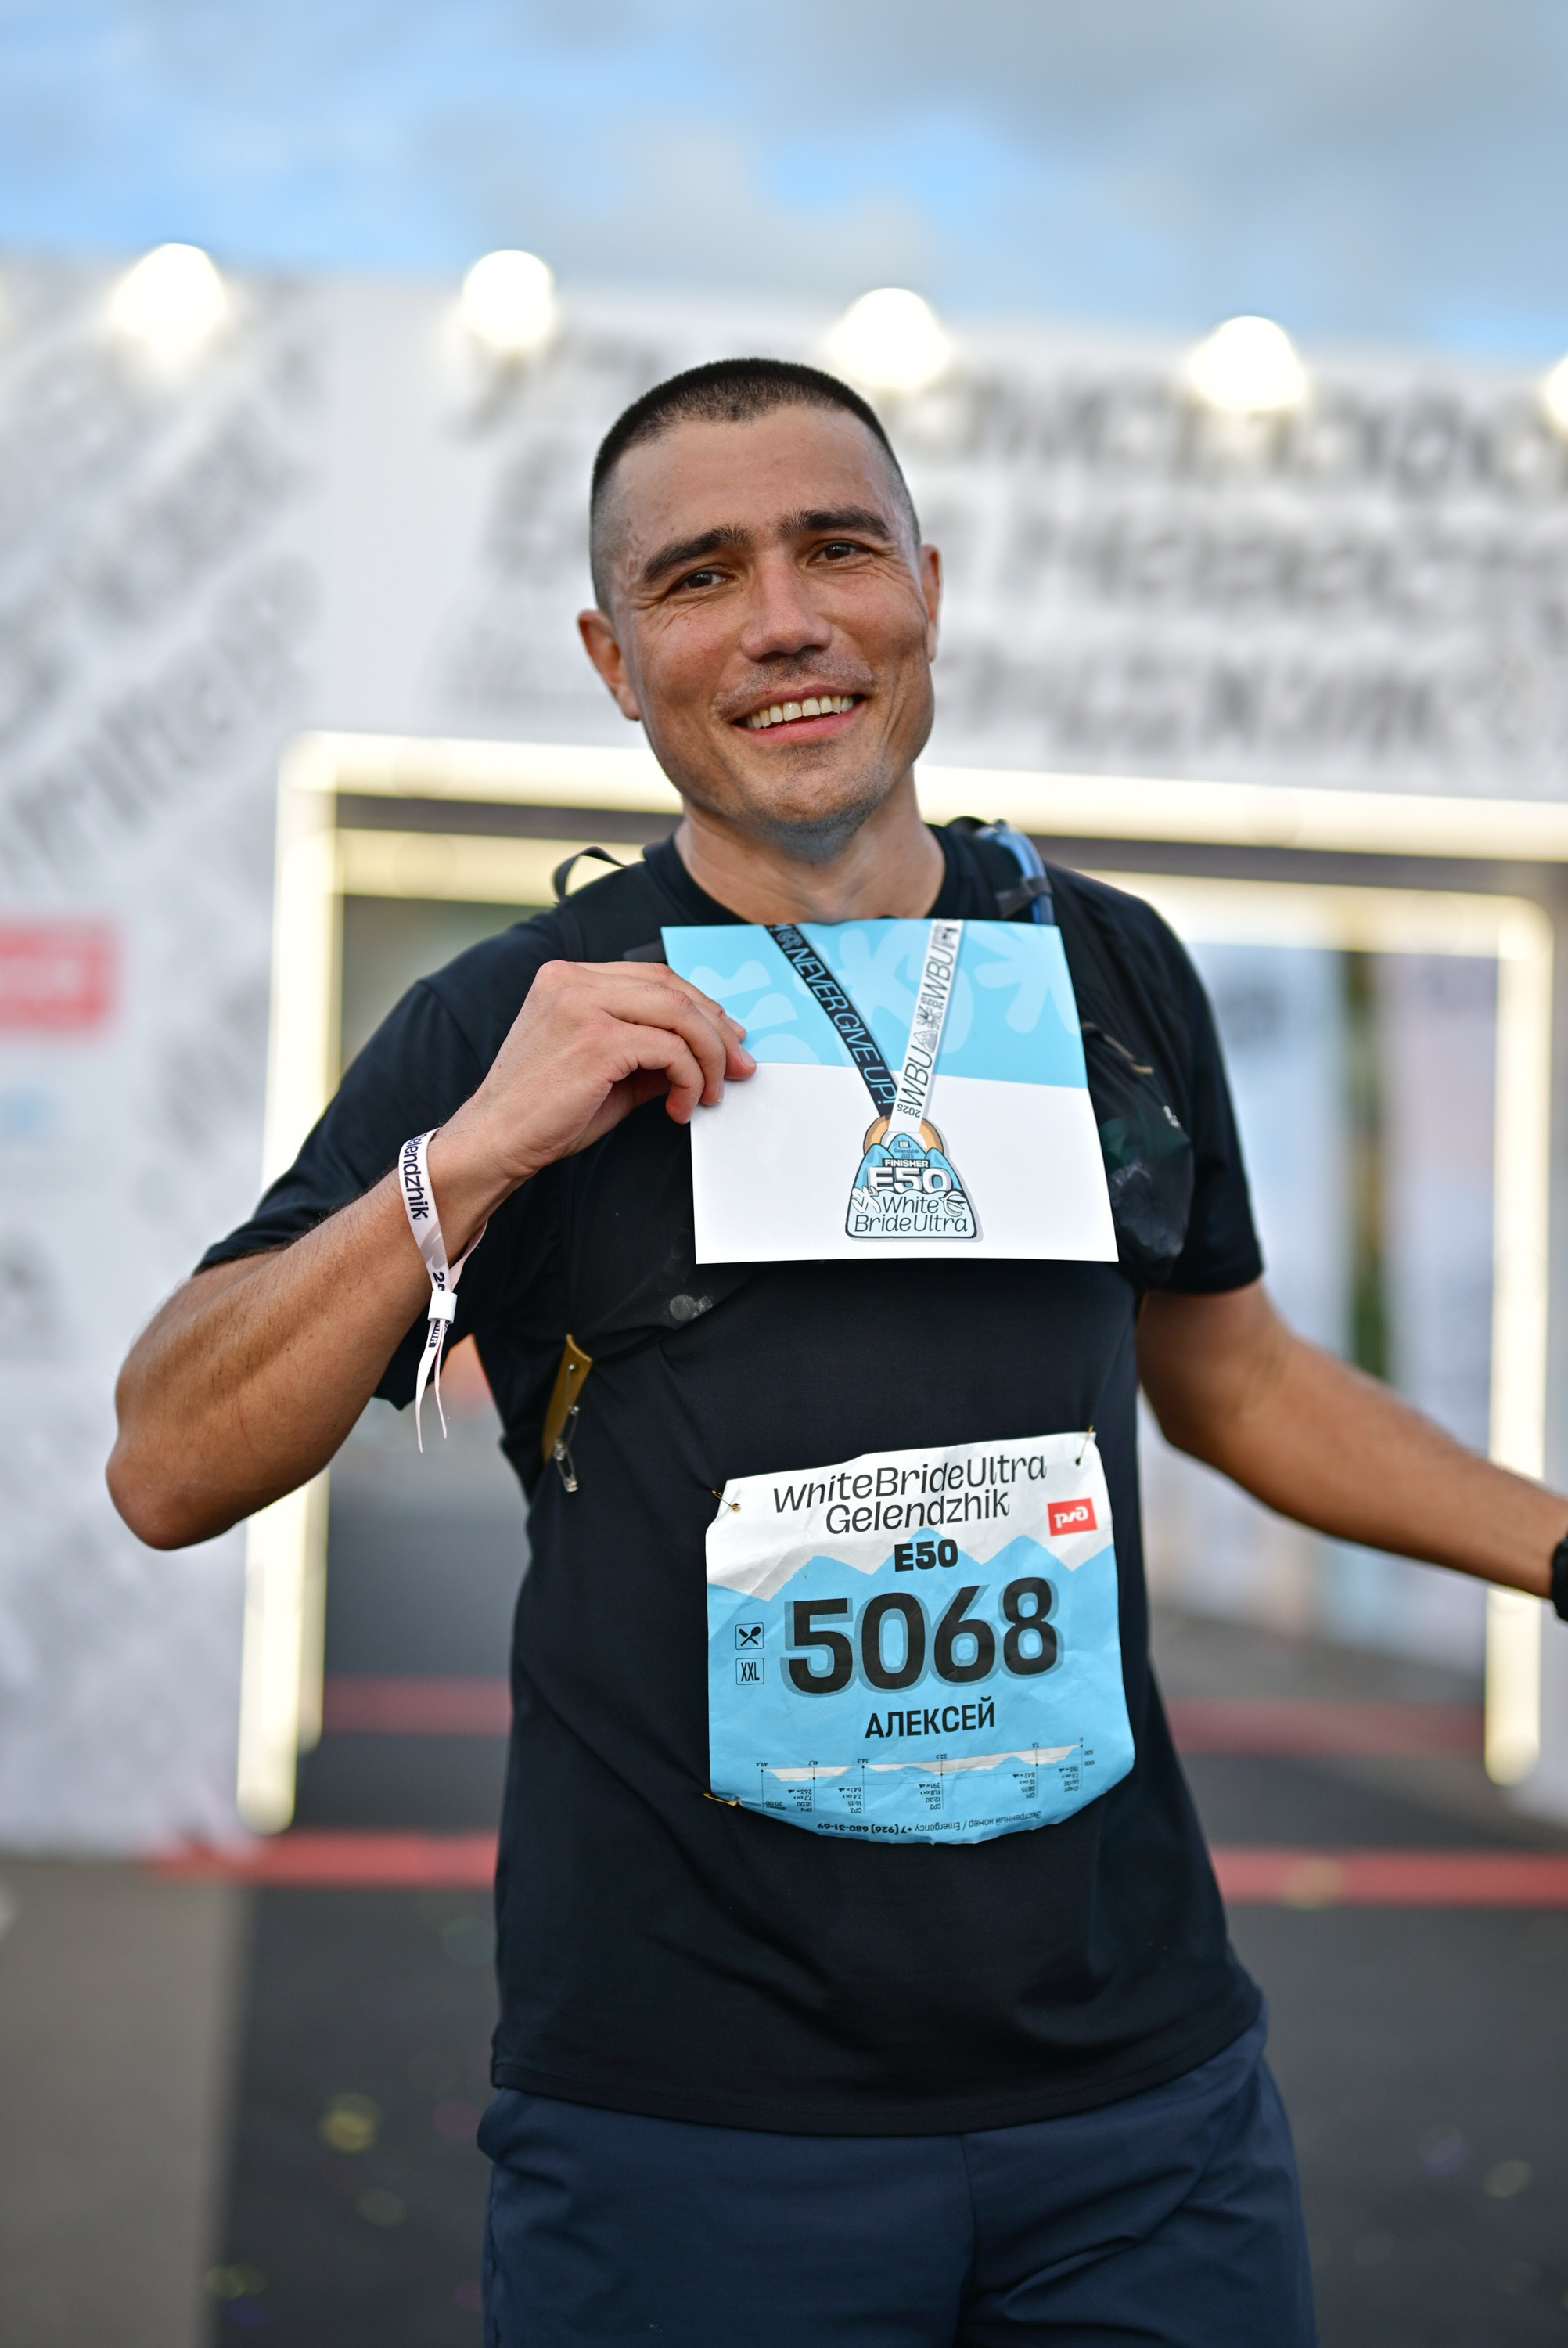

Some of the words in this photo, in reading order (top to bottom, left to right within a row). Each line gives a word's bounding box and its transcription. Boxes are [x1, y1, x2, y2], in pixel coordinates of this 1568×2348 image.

[921, 945, 955, 1004] WBU
[787, 947, 849, 1014] NEVER
[834, 1012, 878, 1069] GIVE
[863, 1065, 898, 1105] UP!
[898, 1045, 933, 1109] WBU
[896, 1102, 922, 1118] 2025
[867, 1167, 951, 1194] E50
[883, 1196, 939, 1214] White
[854, 1215, 968, 1232] BrideUltra
[773, 1453, 1047, 1514] WhiteBrideUltra
[825, 1489, 1011, 1535] Gelendzhik
[894, 1538, 958, 1572] E50
[785, 1576, 1059, 1695] 5068
[739, 1661, 759, 1681] XXL
[865, 1697, 995, 1738] АЛЕКСЕЙ
[818, 1823, 869, 1831] 680-31-69
[871, 1824, 898, 1834] (926)
[915, 1822, 960, 1832] Emergency
[969, 1818, 994, 1828] номер
